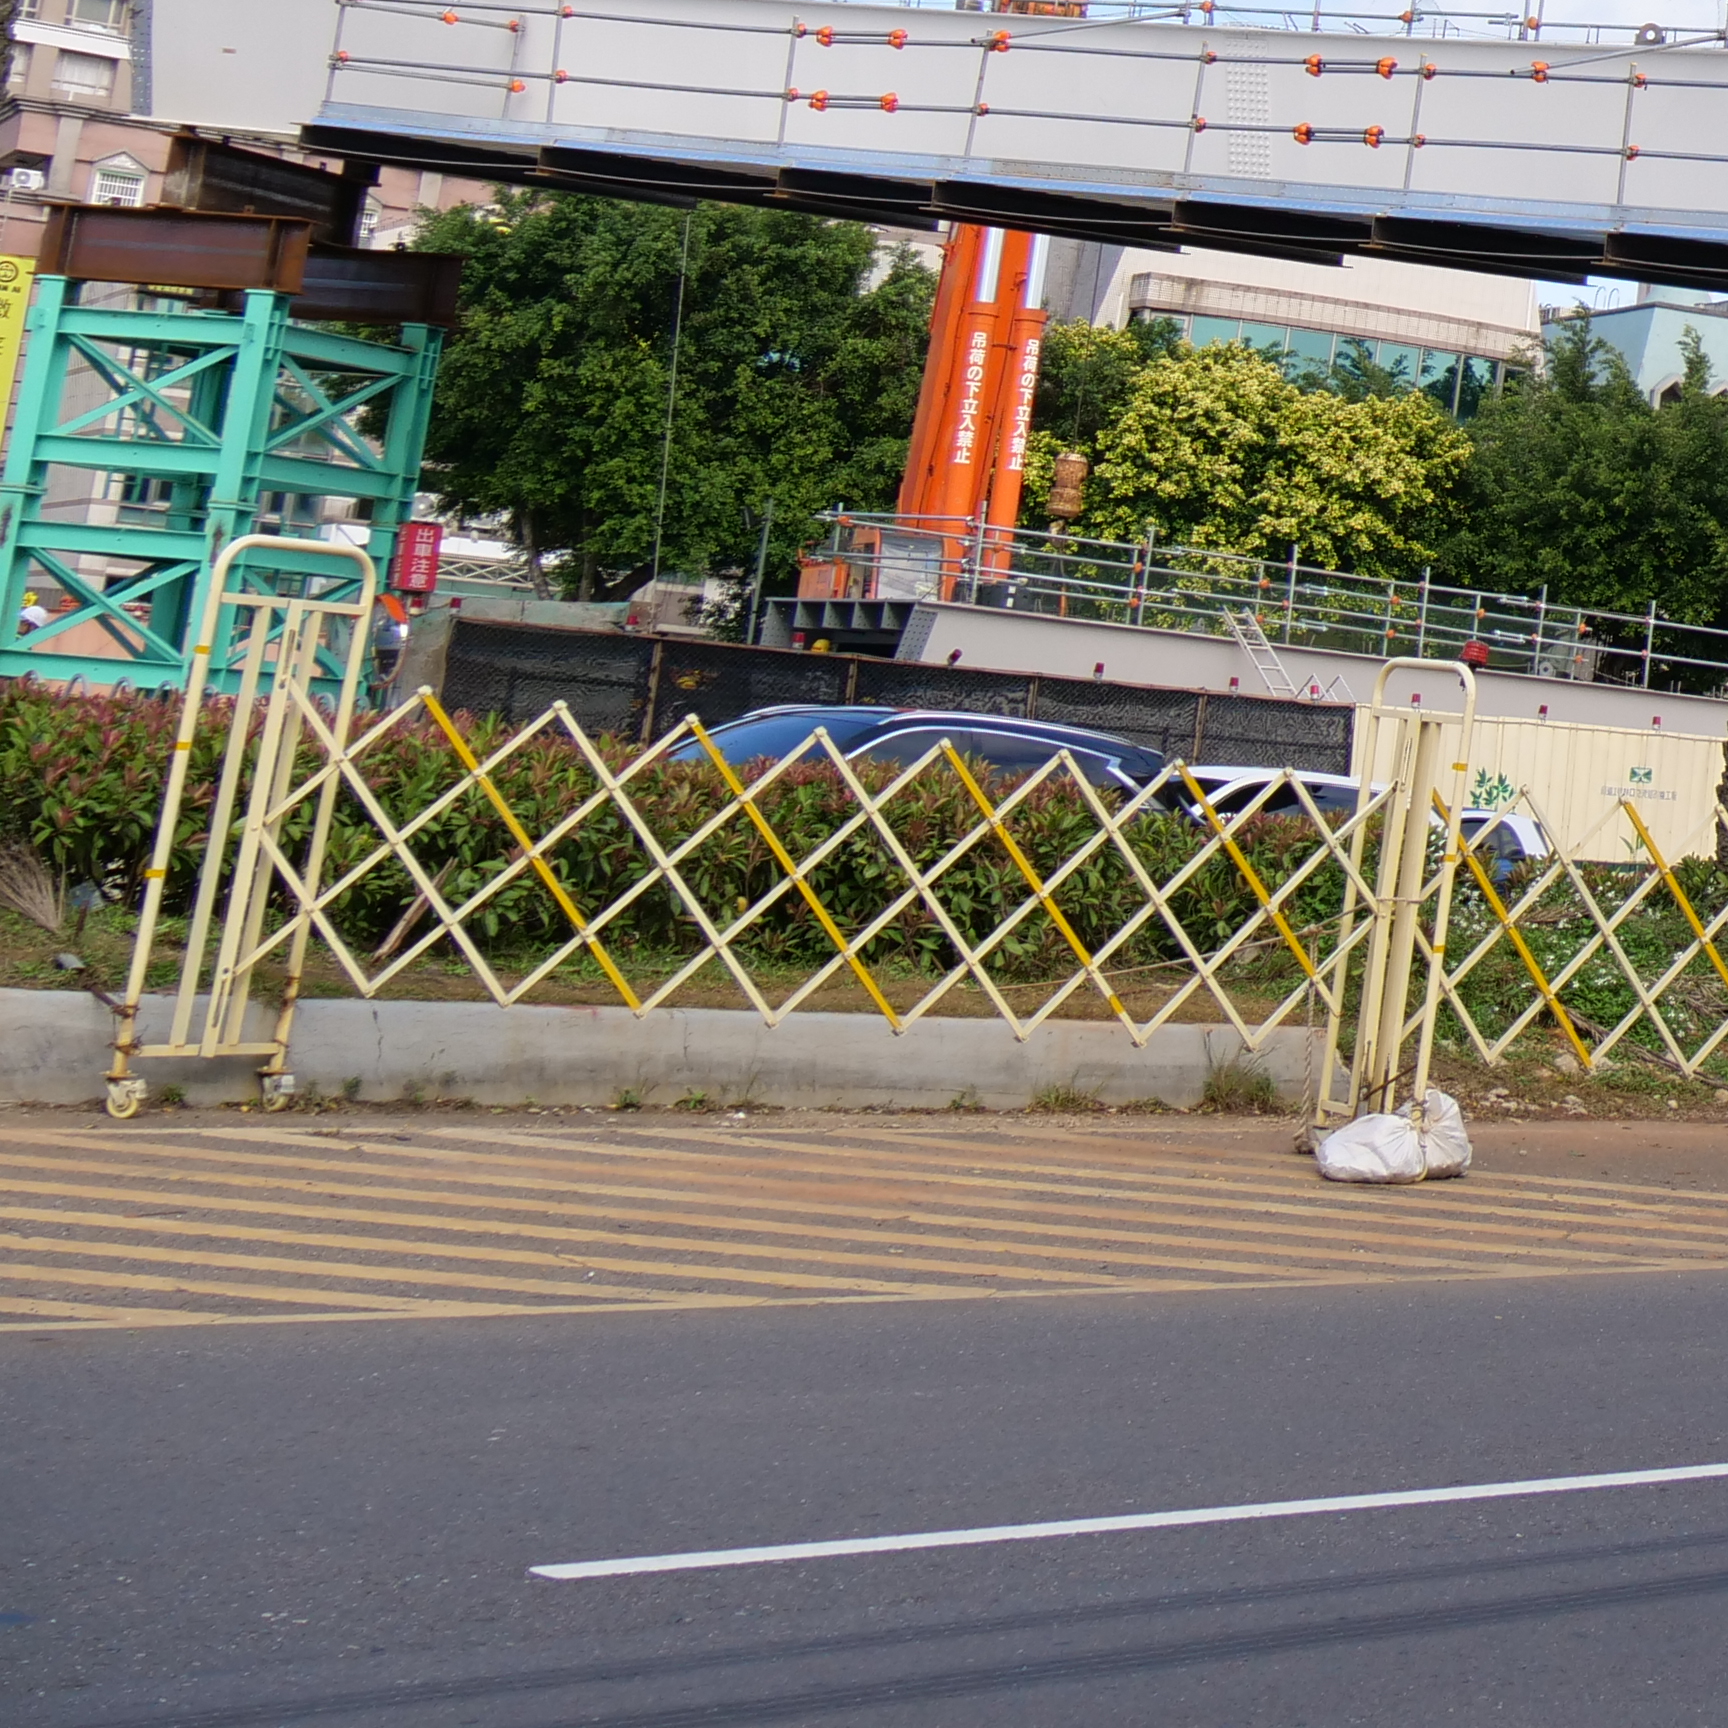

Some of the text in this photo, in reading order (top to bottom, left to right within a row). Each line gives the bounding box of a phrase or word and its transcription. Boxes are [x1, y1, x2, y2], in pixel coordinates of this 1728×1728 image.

[954, 331, 988, 465] 吊荷の下立入禁止
[1007, 338, 1040, 471] 吊荷の下立入禁止
[408, 528, 435, 589] 出車注意
